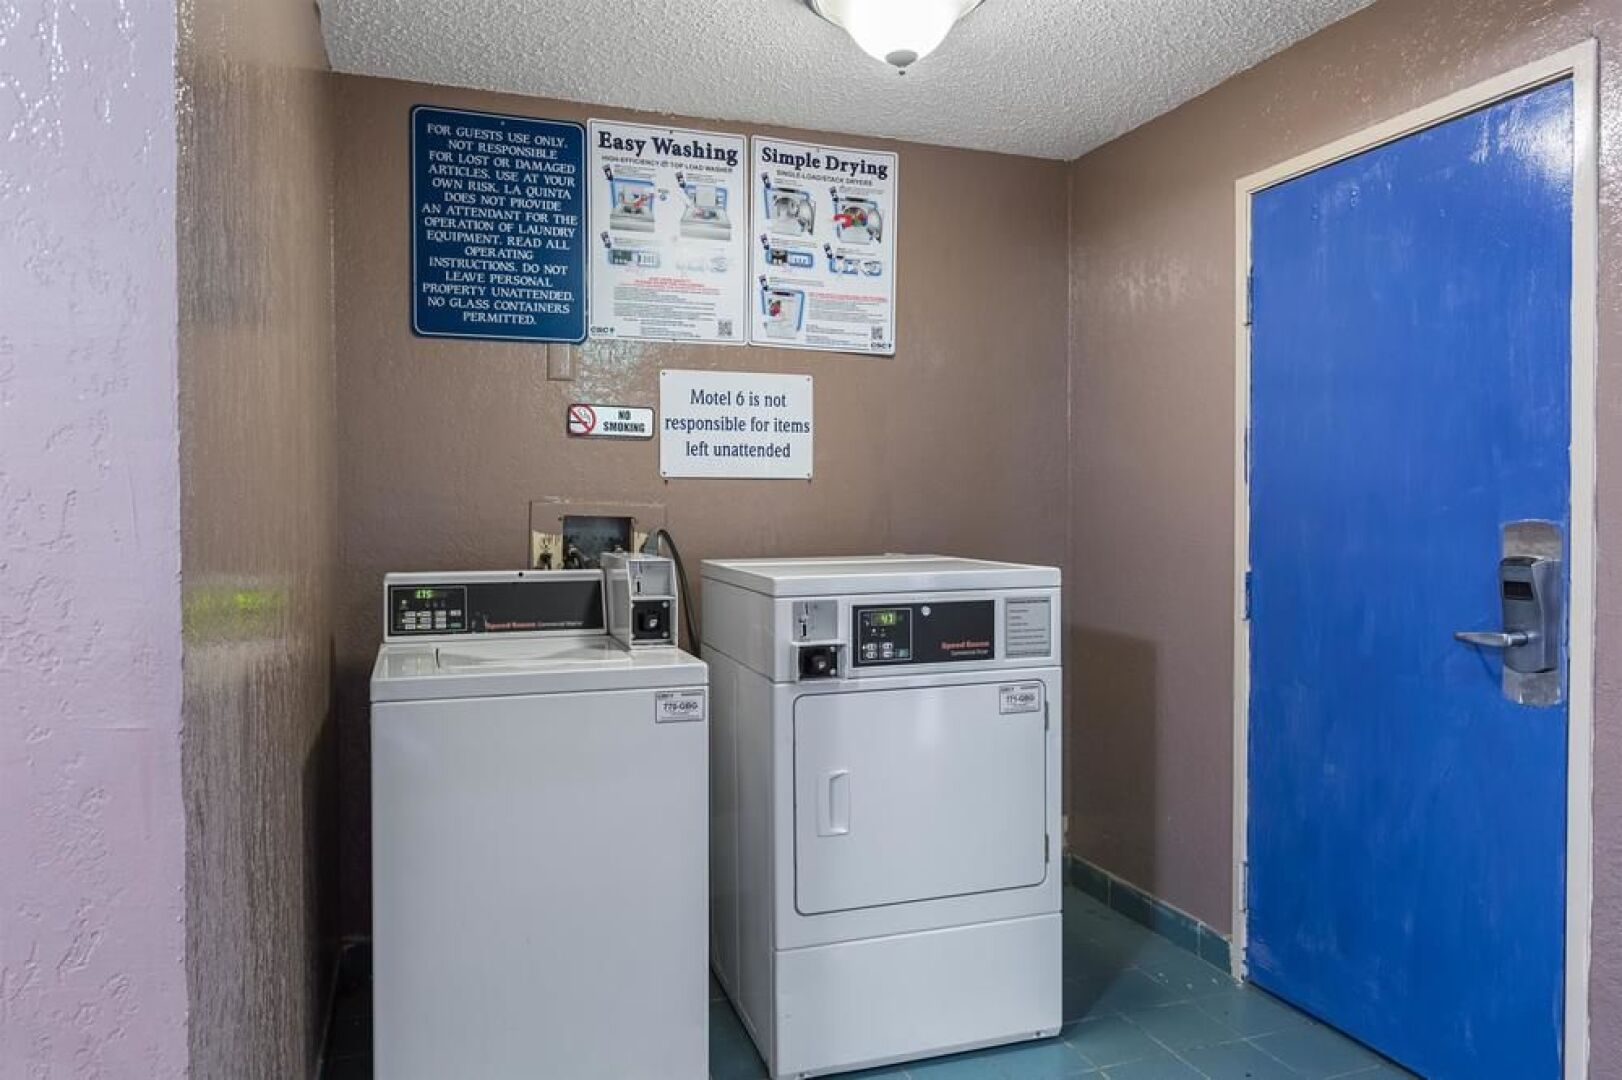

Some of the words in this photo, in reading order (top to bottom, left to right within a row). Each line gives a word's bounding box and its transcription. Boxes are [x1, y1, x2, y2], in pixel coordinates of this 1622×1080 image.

[427, 123, 450, 134] FOR
[456, 127, 504, 140] GUESTS
[508, 132, 529, 143] USE
[534, 135, 567, 147] ONLY.
[449, 140, 472, 150] NOT
[478, 143, 558, 159] RESPONSIBLE
[598, 131, 646, 157] Easy
[651, 136, 739, 166] Washing
[429, 151, 453, 162] FOR
[459, 154, 488, 165] LOST
[493, 157, 510, 167] OR
[516, 159, 575, 174] DAMAGED
[762, 147, 820, 170] Simple
[825, 155, 888, 180] Drying
[428, 165, 491, 179] ARTICLES.
[496, 170, 518, 181] USE
[524, 173, 538, 182] AT
[544, 174, 575, 186] YOUR
[432, 178, 463, 189] OWN
[468, 181, 499, 193] RISK.
[504, 185, 522, 195] LA
[527, 187, 571, 199] QUINTA
[444, 192, 476, 203] DOES
[481, 195, 507, 206] NOT
[510, 198, 561, 211] PROVIDE
[421, 204, 441, 214] AN
[446, 206, 521, 221] ATTENDANT
[526, 212, 548, 223] FOR
[554, 215, 578, 225] THE
[424, 217, 494, 231] OPERATION
[498, 223, 514, 232] OF
[519, 224, 575, 237] LAUNDRY
[427, 230, 503, 245] EQUIPMENT.
[507, 237, 541, 247] READ
[546, 240, 570, 250] ALL
[465, 246, 532, 259] OPERATING
[429, 258, 518, 272] INSTRUCTIONS.
[523, 263, 539, 273] DO
[544, 264, 568, 274] NOT
[445, 272, 485, 283] LEAVE
[490, 275, 552, 287] PERSONAL
[423, 283, 486, 296] PROPERTY
[491, 288, 574, 301] UNATTENDED.
[428, 297, 444, 307] NO
[449, 298, 489, 309] GLASS
[493, 301, 570, 313] CONTAINERS
[463, 312, 536, 324] PERMITTED.
[690, 389, 731, 406] Motel
[736, 390, 744, 406] 6
[749, 392, 760, 406] is
[764, 394, 786, 408] not
[618, 410, 631, 420] NO
[603, 422, 645, 433] SMOKING
[665, 417, 745, 434] responsible
[750, 417, 768, 432] for
[773, 418, 810, 434] items
[686, 441, 708, 456] left
[714, 442, 791, 458] unattended
